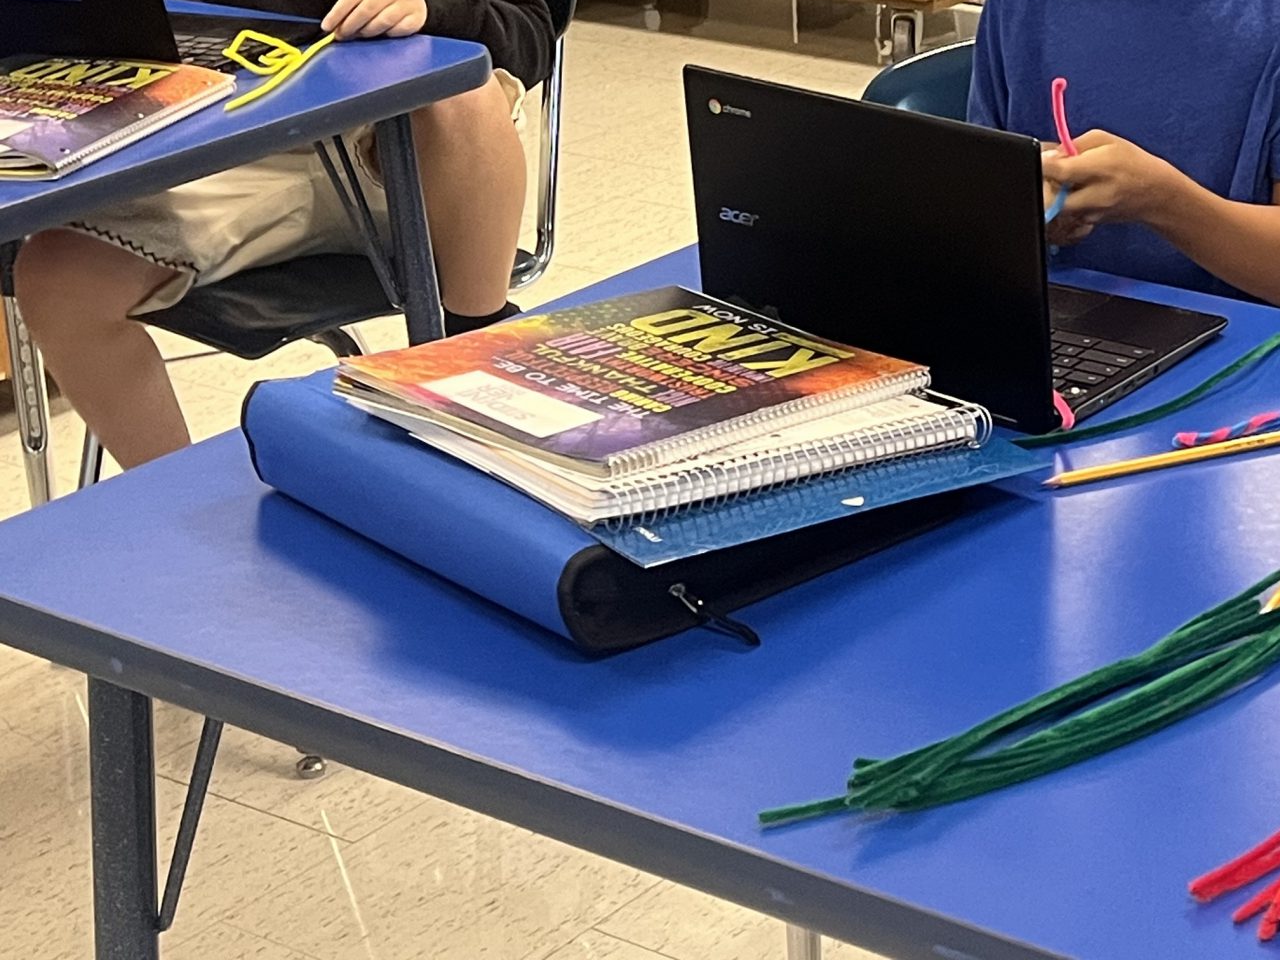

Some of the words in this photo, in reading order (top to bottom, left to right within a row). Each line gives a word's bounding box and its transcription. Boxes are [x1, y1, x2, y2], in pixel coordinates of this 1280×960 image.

[720, 207, 760, 227] acer
[693, 303, 749, 324] NOW
[746, 322, 777, 334] IS
[630, 308, 841, 378] KIND
[533, 343, 657, 393] THANKFUL
[616, 350, 737, 394] COOPERATIVE
[525, 372, 553, 386] TO
[556, 382, 609, 404] TIME
[608, 403, 650, 419] THE
